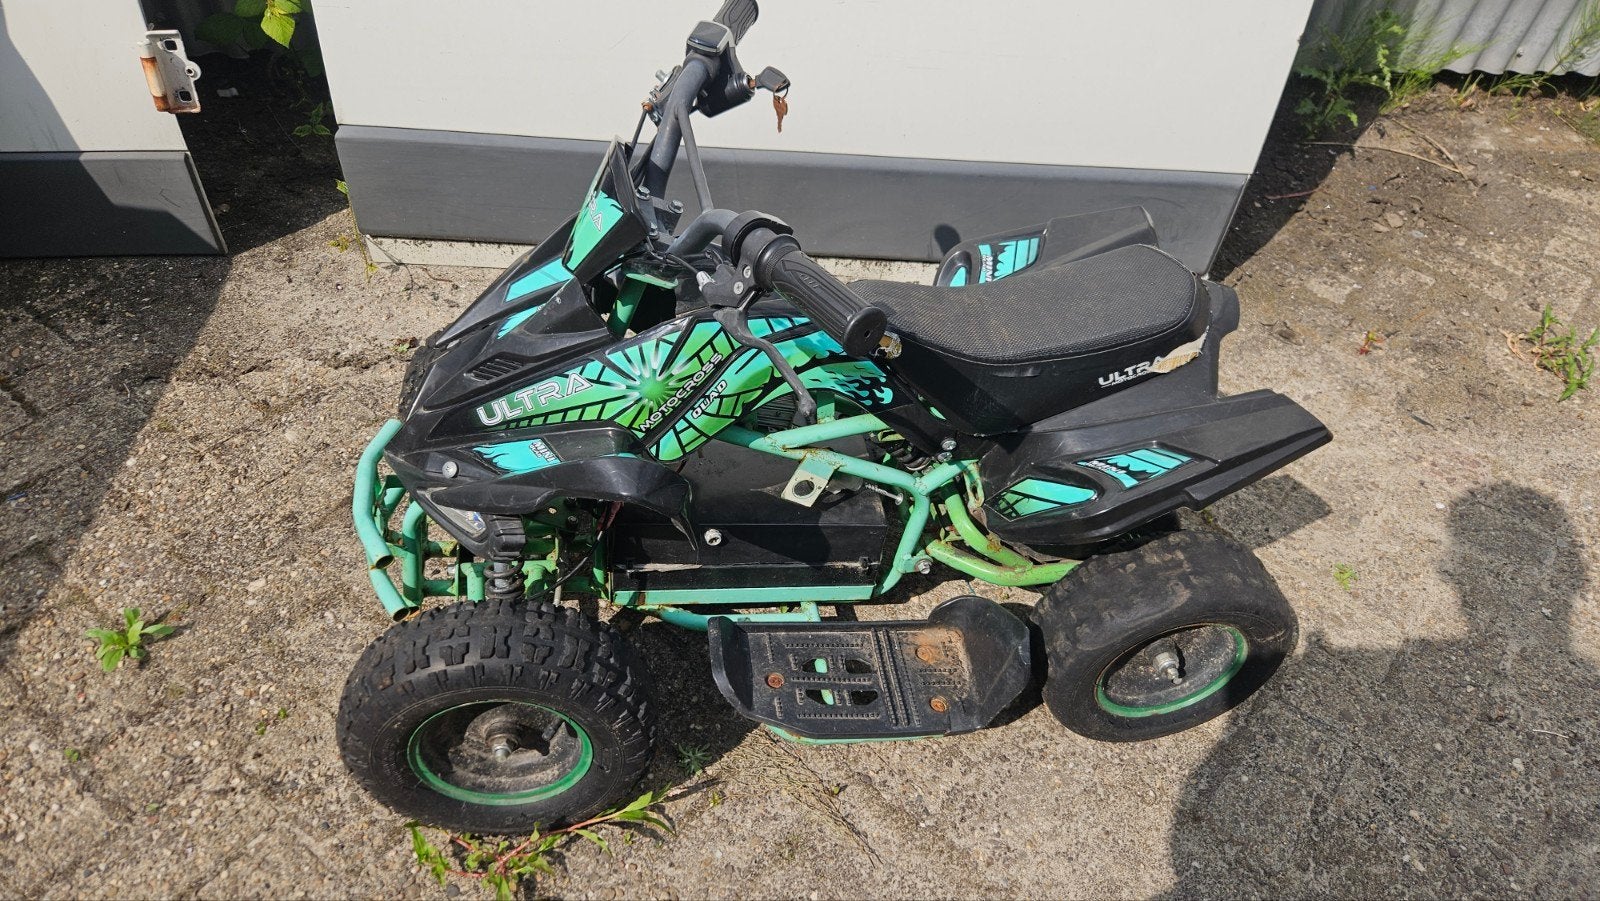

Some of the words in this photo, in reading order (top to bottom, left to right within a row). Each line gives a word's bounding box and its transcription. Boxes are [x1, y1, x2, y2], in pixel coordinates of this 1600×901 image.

[476, 372, 594, 426] ULTRA
[639, 352, 723, 432] MOTOCROSS
[690, 379, 728, 420] QUAD
[531, 440, 556, 462] MINI
